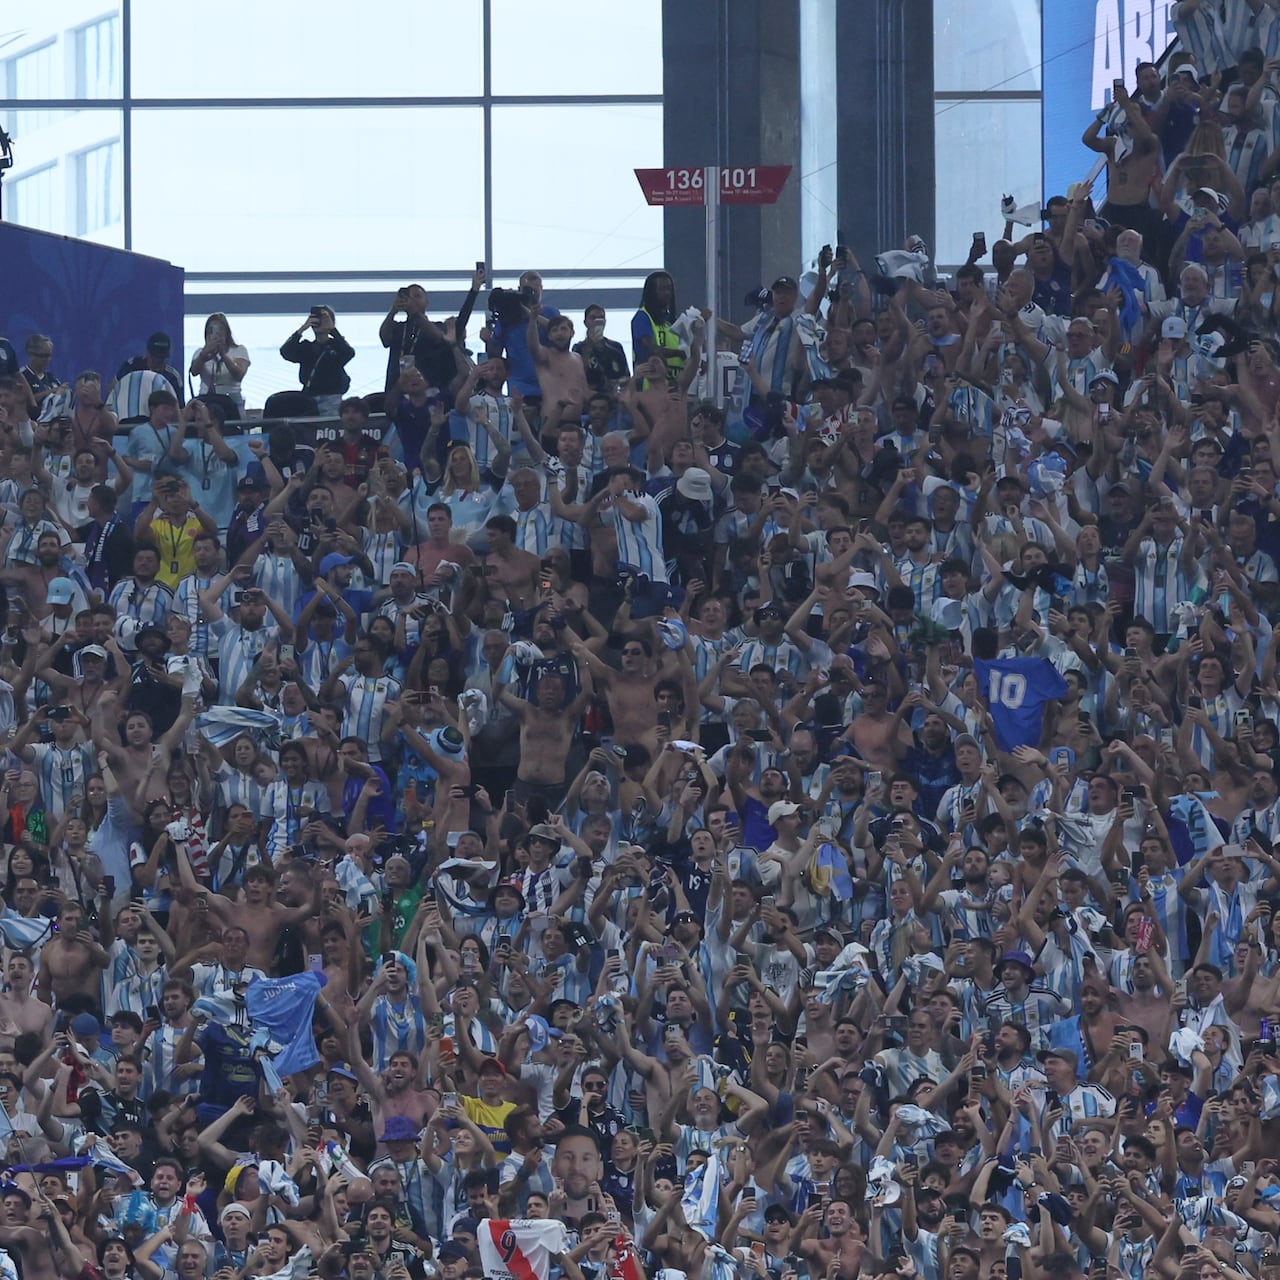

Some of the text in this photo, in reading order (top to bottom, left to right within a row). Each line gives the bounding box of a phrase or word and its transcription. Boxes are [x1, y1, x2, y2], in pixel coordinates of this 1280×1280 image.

[666, 169, 704, 190] 136
[721, 167, 757, 188] 101
[988, 668, 1028, 710] 10
[689, 874, 703, 891] 19
[500, 1230, 517, 1263] 9
